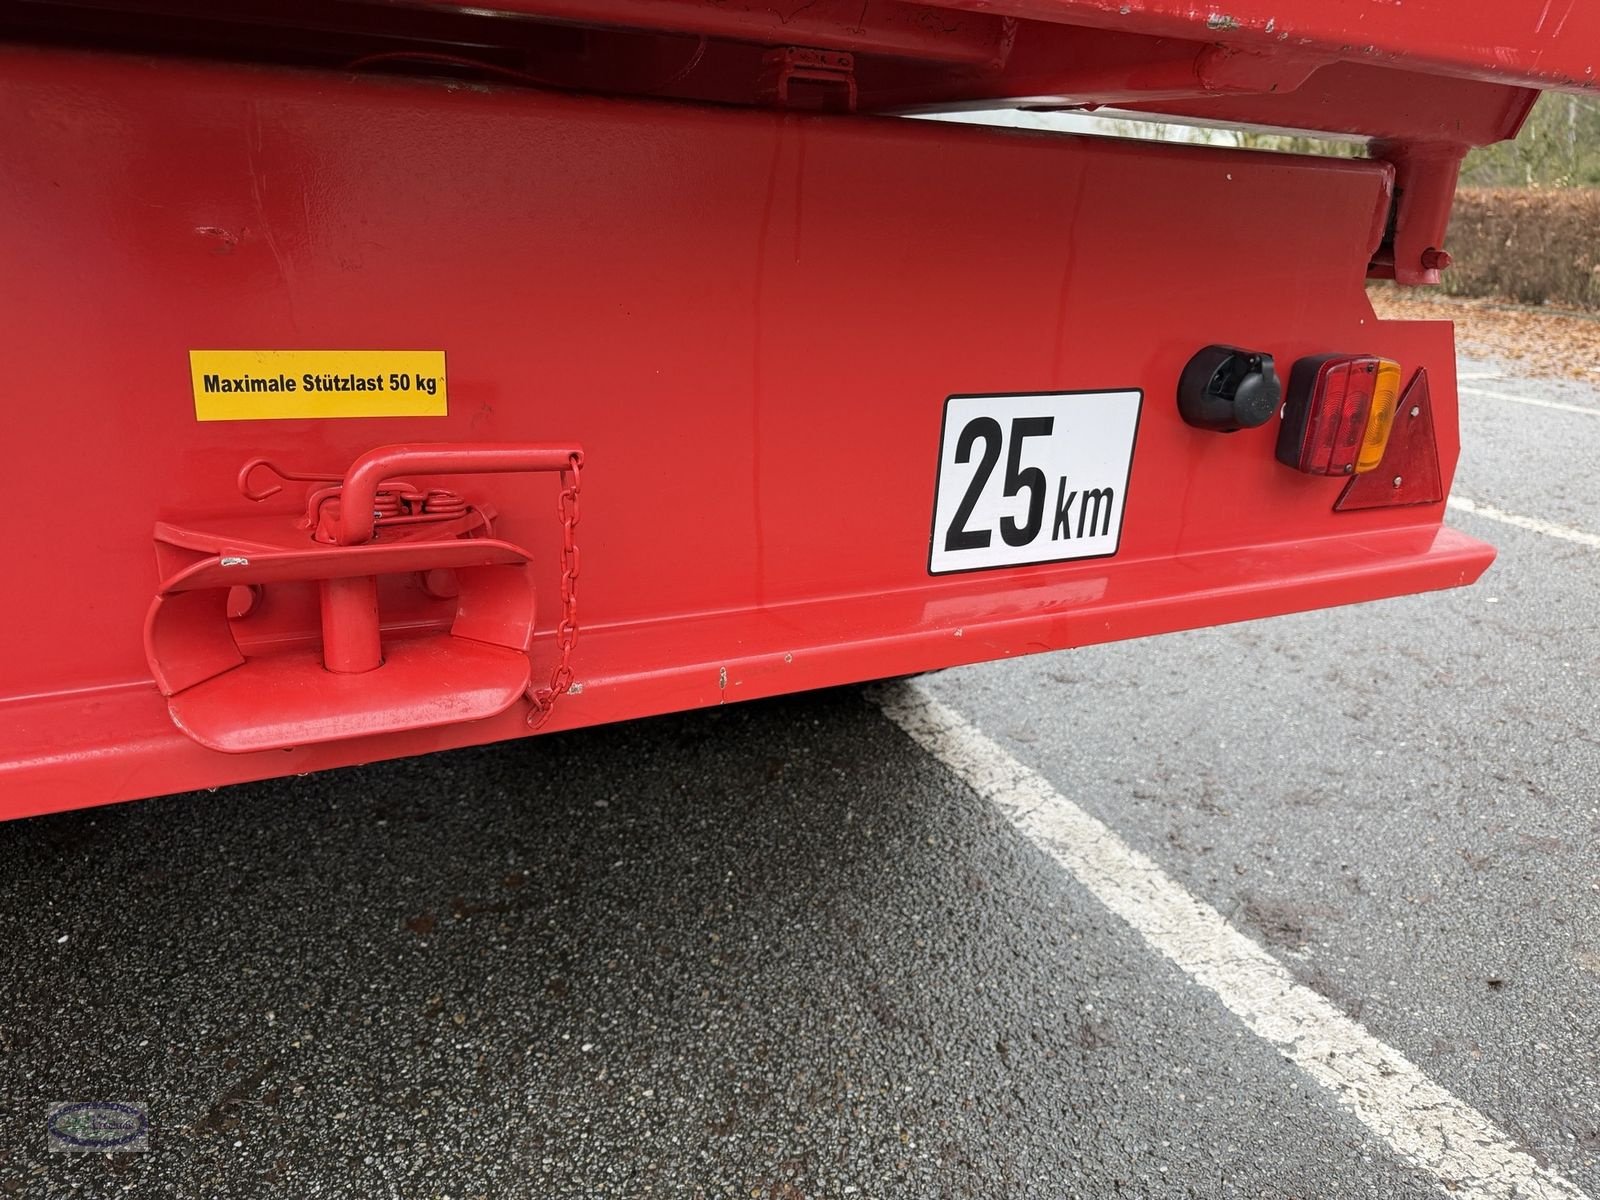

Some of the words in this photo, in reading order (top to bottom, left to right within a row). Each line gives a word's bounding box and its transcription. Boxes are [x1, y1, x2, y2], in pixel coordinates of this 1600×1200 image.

[203, 374, 297, 393] Maximale
[302, 373, 384, 392] Stützlast
[389, 373, 411, 391] 50
[416, 373, 437, 395] kg
[944, 416, 1055, 552] 25
[1051, 475, 1114, 541] km
